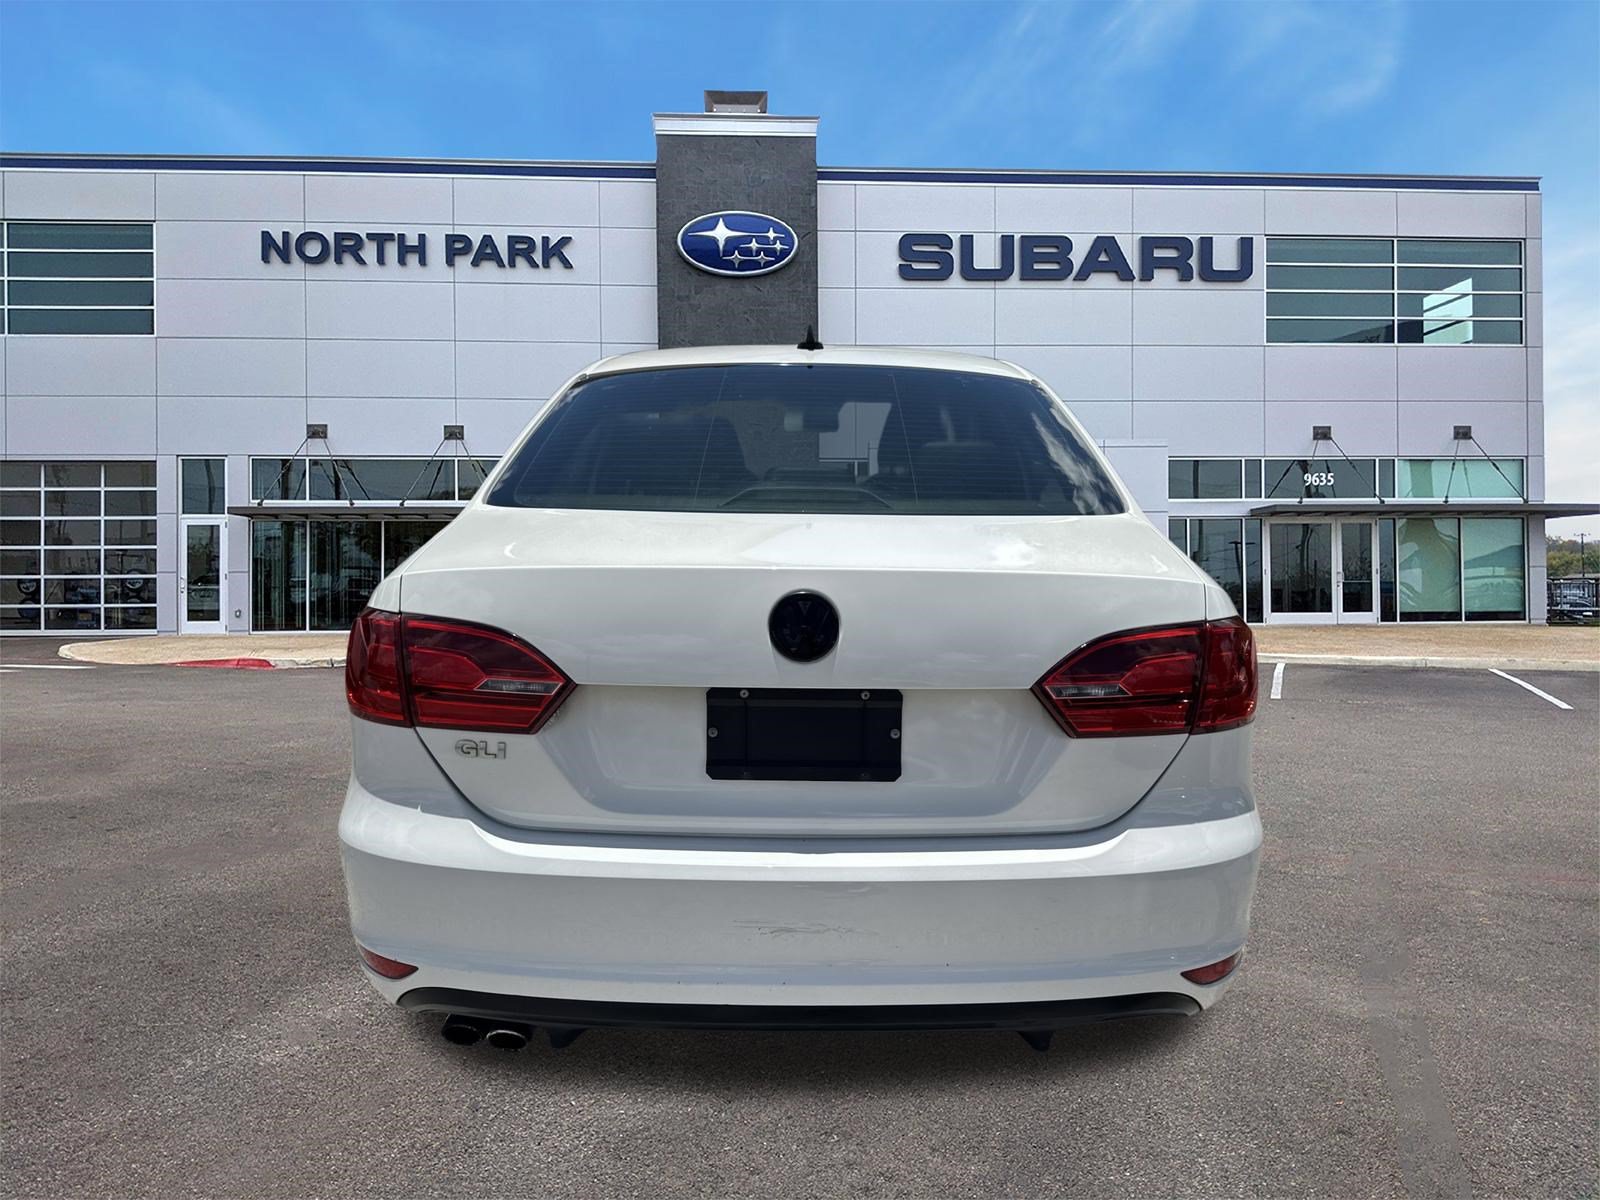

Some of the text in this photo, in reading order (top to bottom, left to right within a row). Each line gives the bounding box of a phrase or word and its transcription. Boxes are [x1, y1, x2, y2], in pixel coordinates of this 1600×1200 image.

[261, 230, 574, 269] NORTH PARK
[898, 232, 1254, 283] SUBARU
[1304, 472, 1334, 486] 9635
